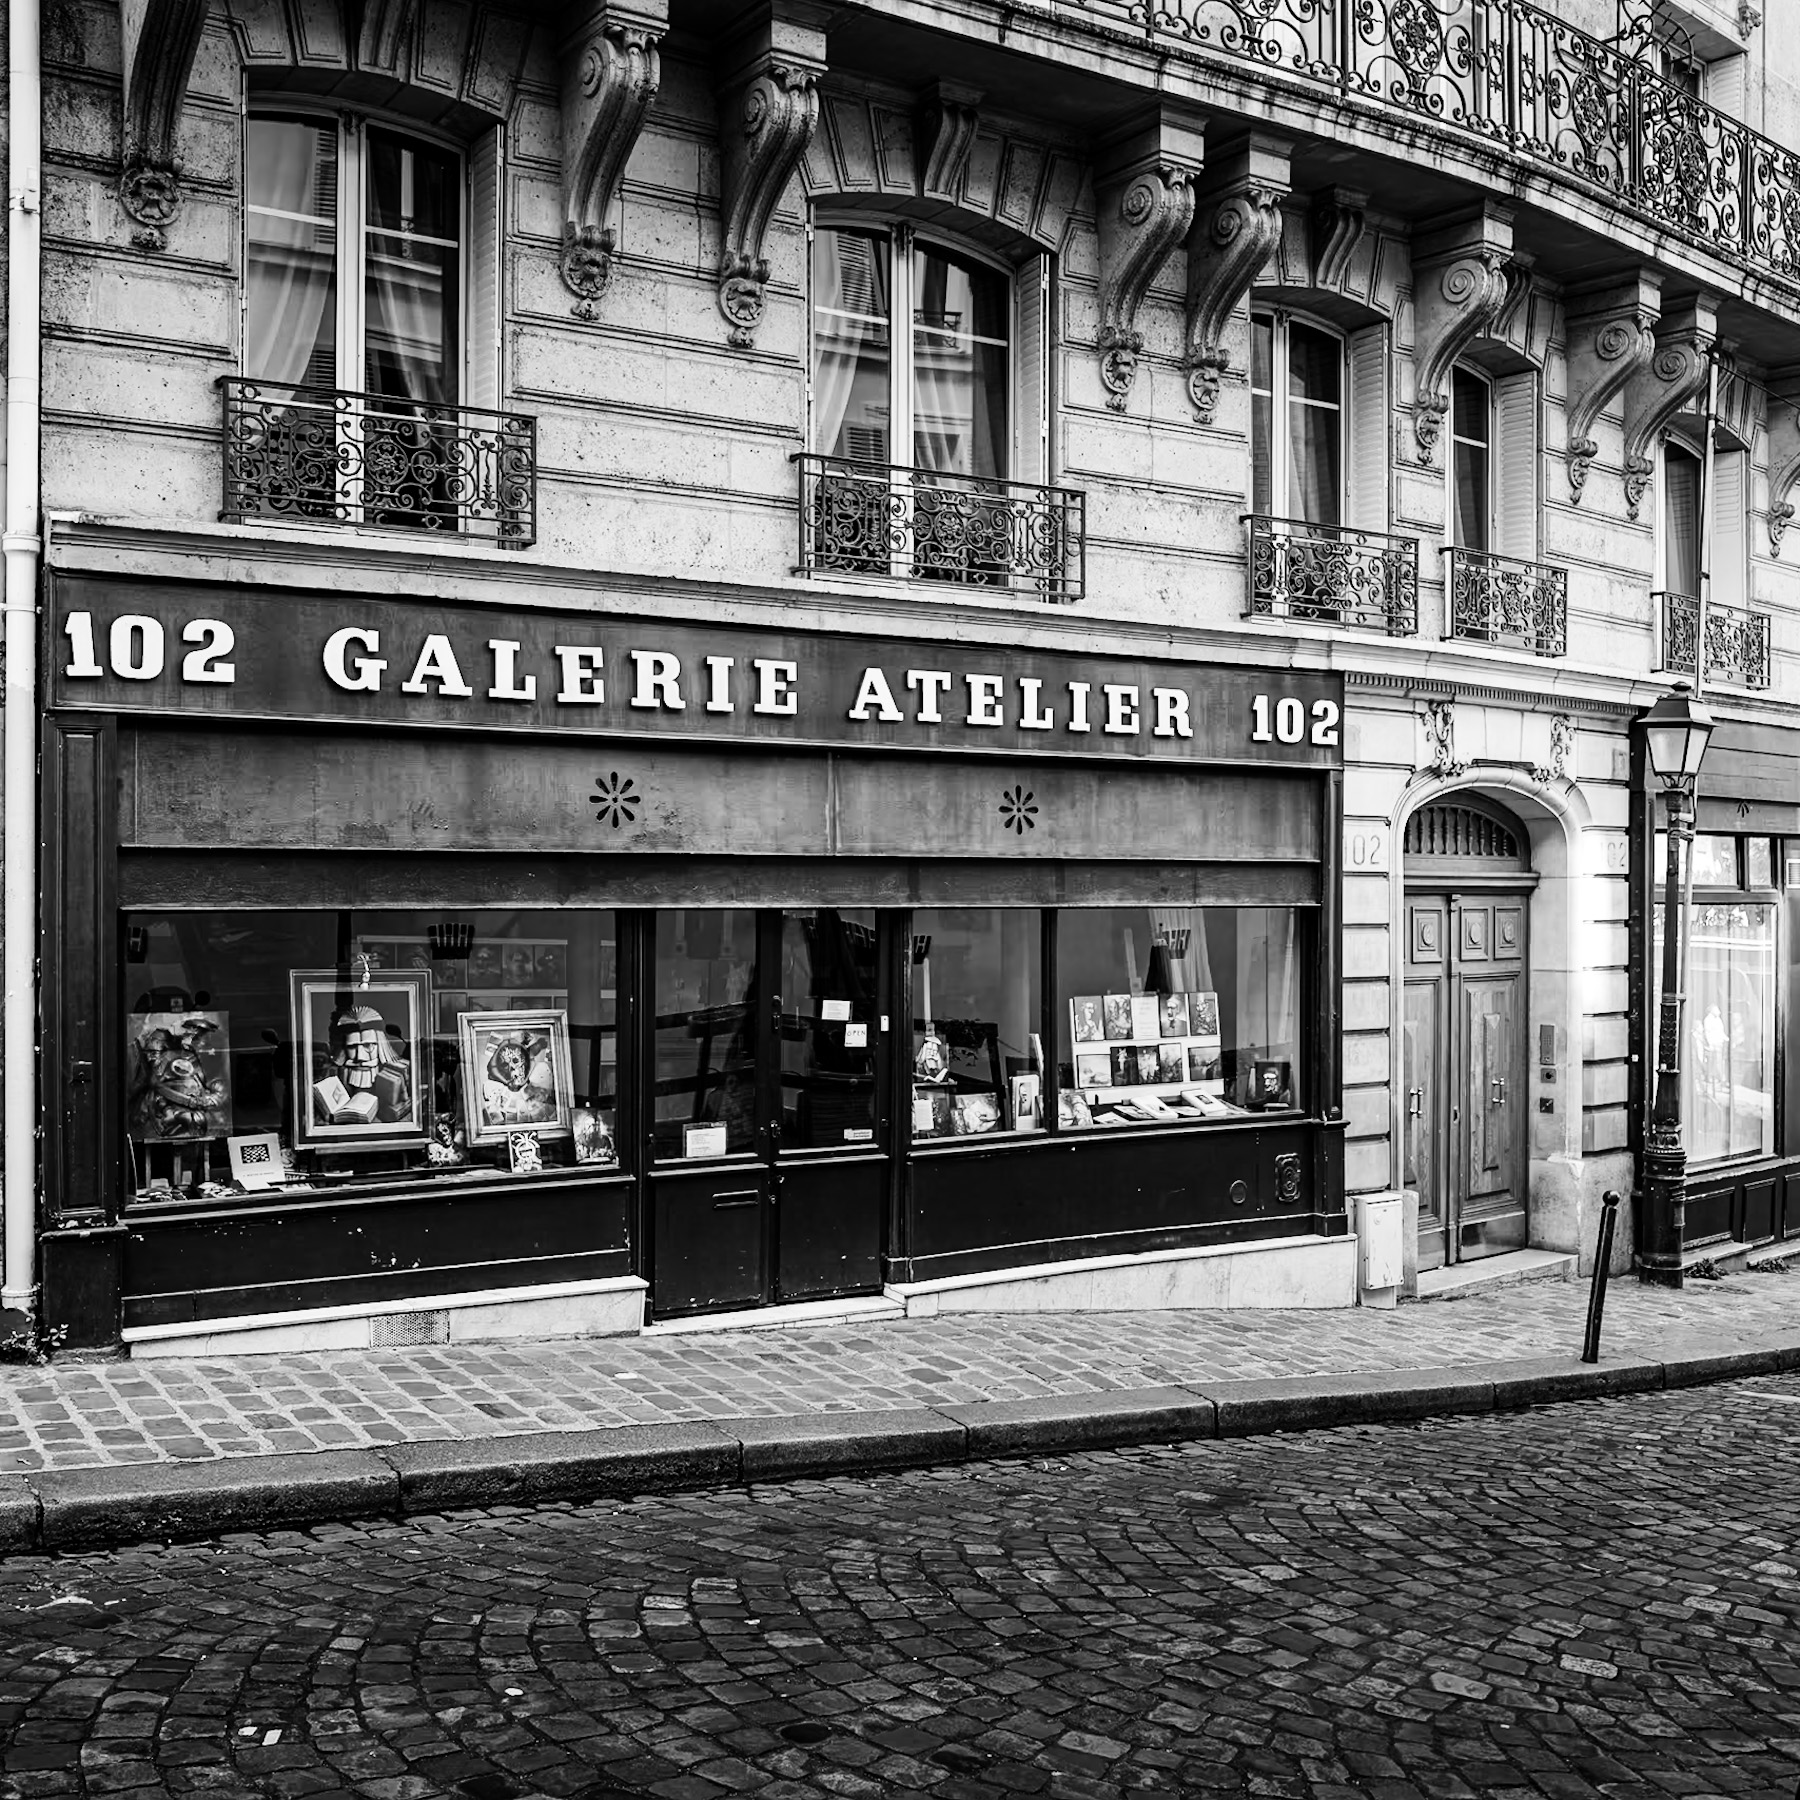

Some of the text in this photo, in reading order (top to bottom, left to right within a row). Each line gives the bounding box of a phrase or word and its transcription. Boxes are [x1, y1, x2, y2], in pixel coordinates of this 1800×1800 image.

[65, 612, 1340, 746] 102 GALERIE ATELIER 102
[1344, 834, 1381, 866] 102
[1605, 842, 1627, 868] 02
